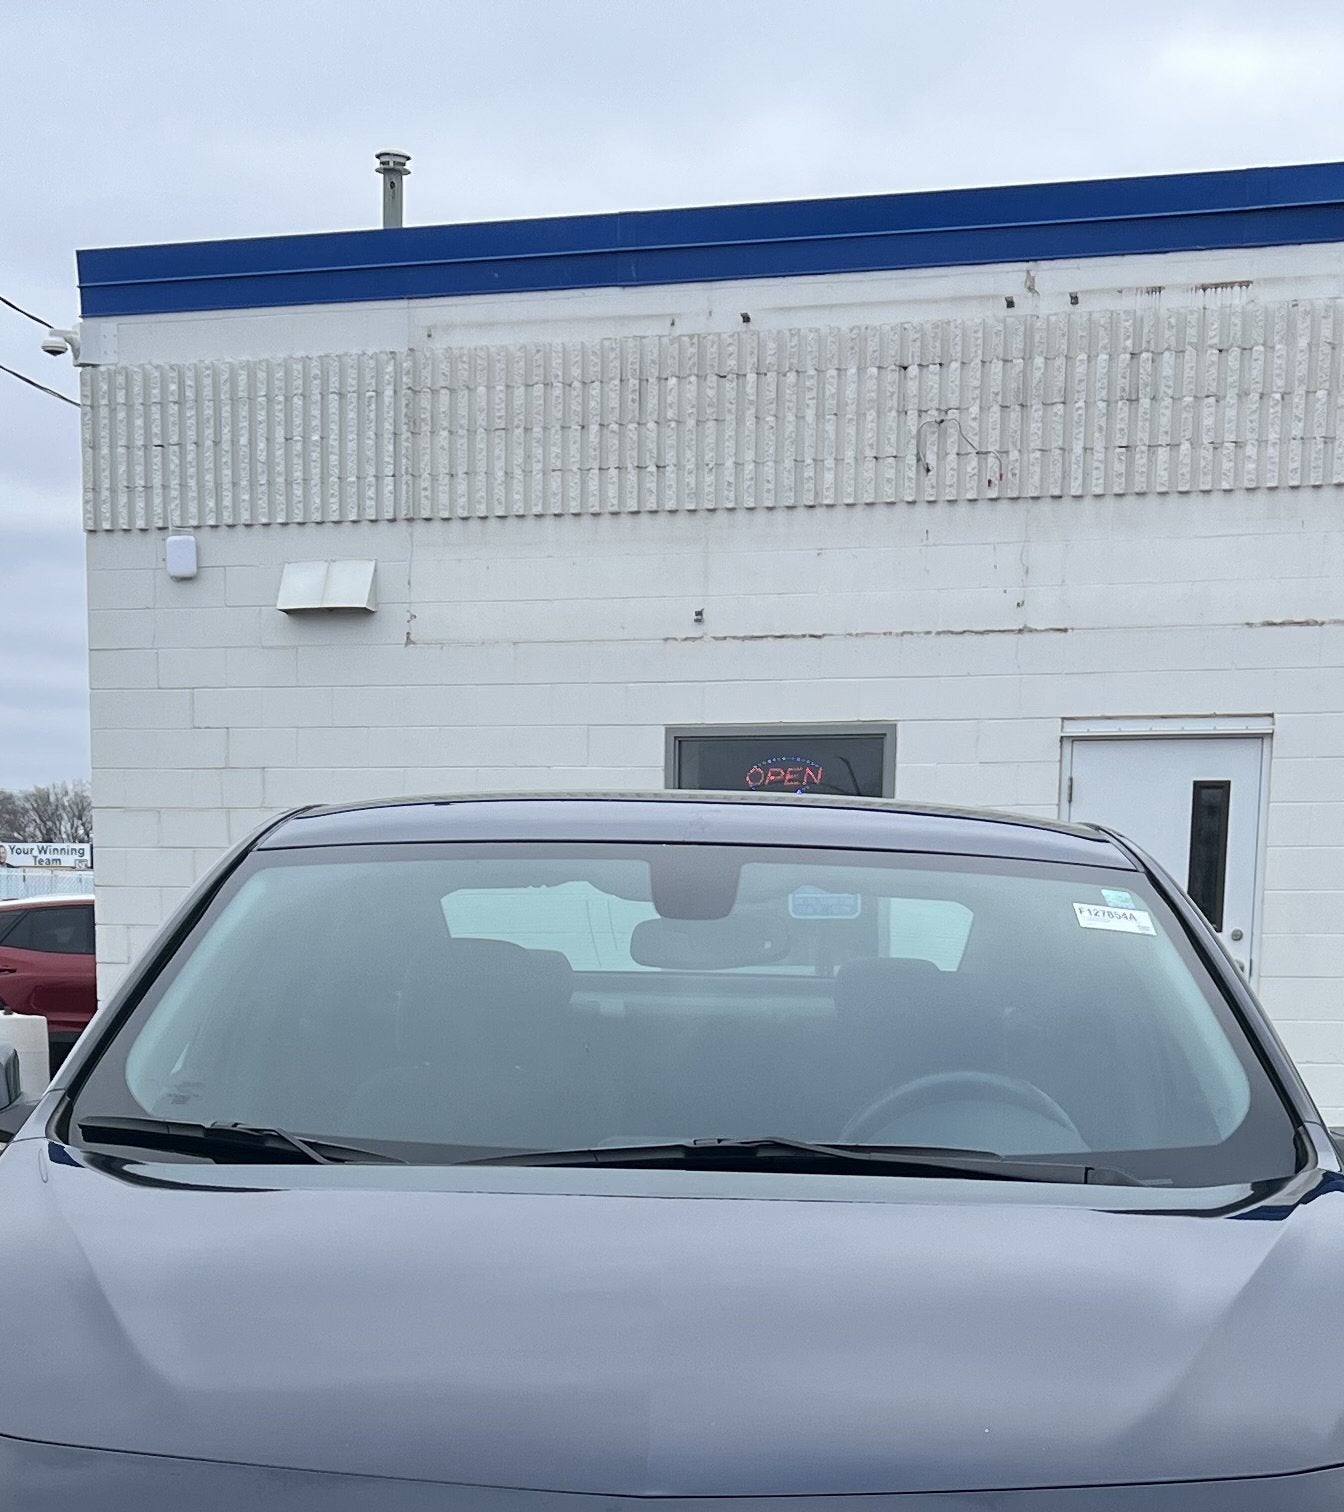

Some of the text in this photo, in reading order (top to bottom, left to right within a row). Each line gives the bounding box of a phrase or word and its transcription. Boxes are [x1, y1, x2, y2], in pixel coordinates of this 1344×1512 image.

[746, 767, 823, 786] OPEN
[8, 845, 85, 857] Your Winning
[32, 856, 62, 866] Team
